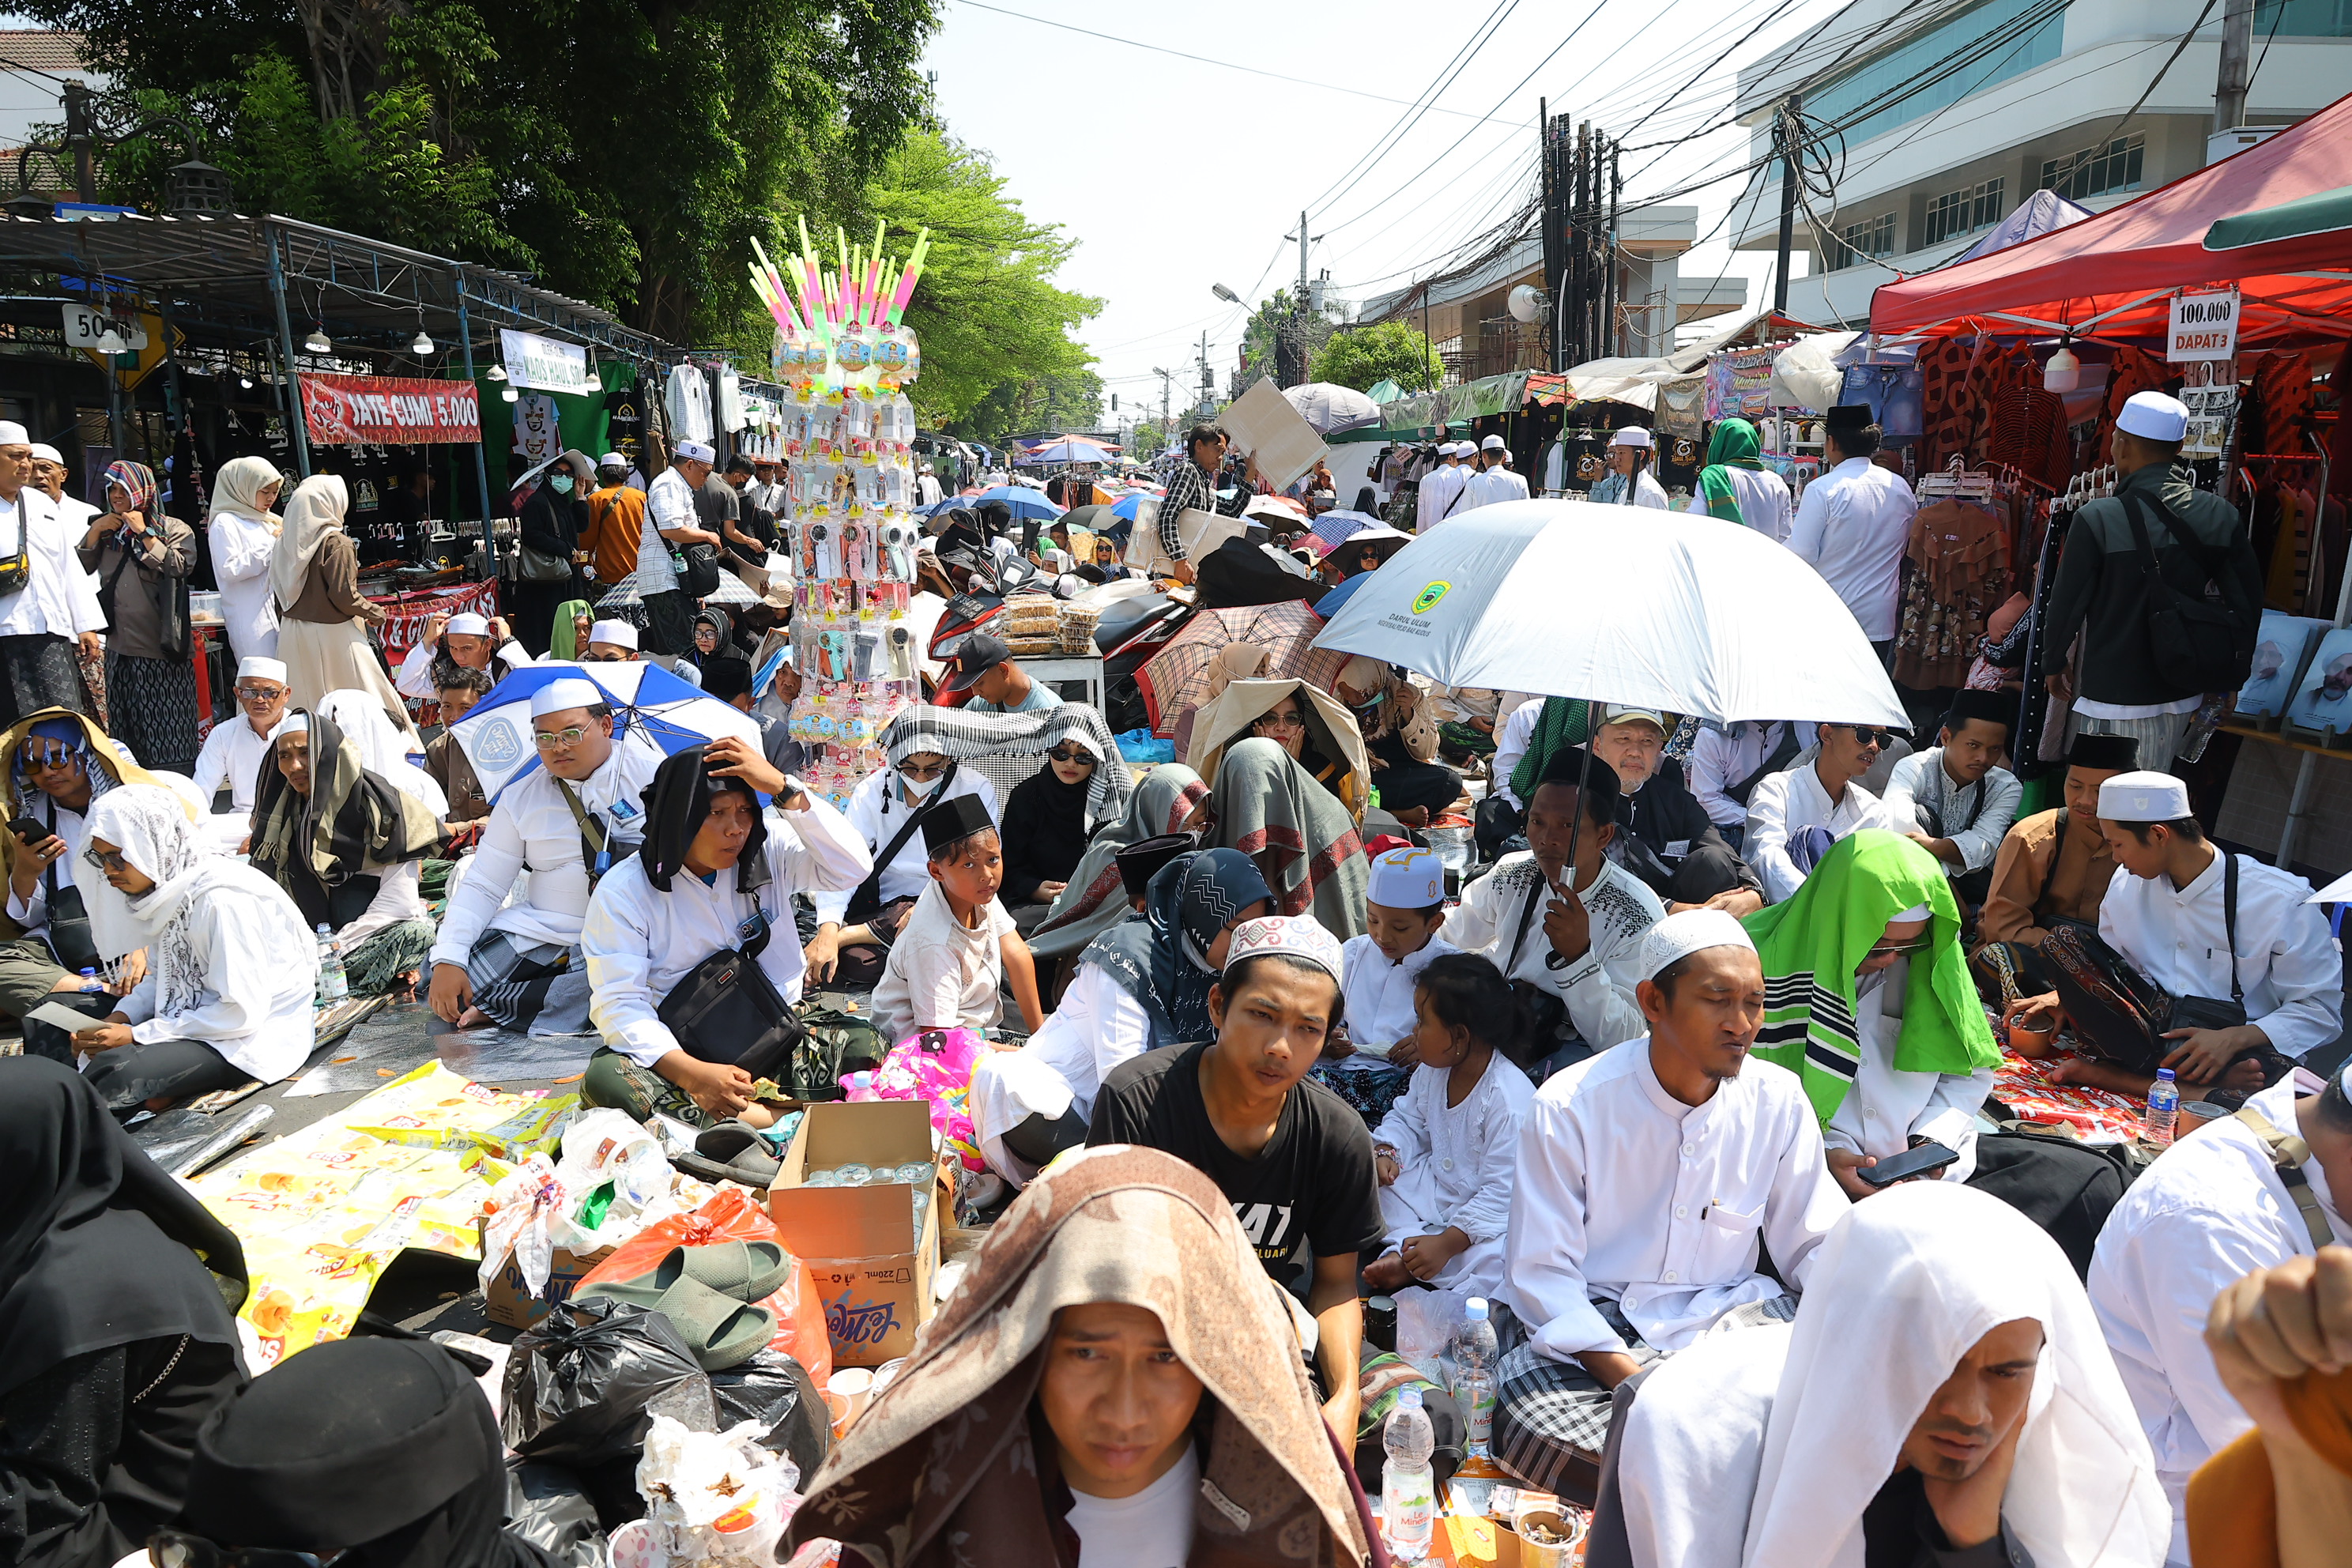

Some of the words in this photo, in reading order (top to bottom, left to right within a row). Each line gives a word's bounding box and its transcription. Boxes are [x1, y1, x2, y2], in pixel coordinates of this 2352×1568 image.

[2180, 301, 2230, 323] 100.000
[2176, 334, 2219, 349] DAPAT
[2220, 335, 2228, 348] 3
[523, 355, 548, 380] KAOS
[548, 360, 570, 385] HAUL
[1732, 373, 1756, 390] Mulai
[347, 394, 393, 426] SATE
[390, 394, 435, 426] CUMI
[435, 396, 478, 426] 5.000
[1389, 613, 1409, 624] DARUL
[1411, 617, 1431, 628] ULUM
[865, 1270, 894, 1279] 220mL
